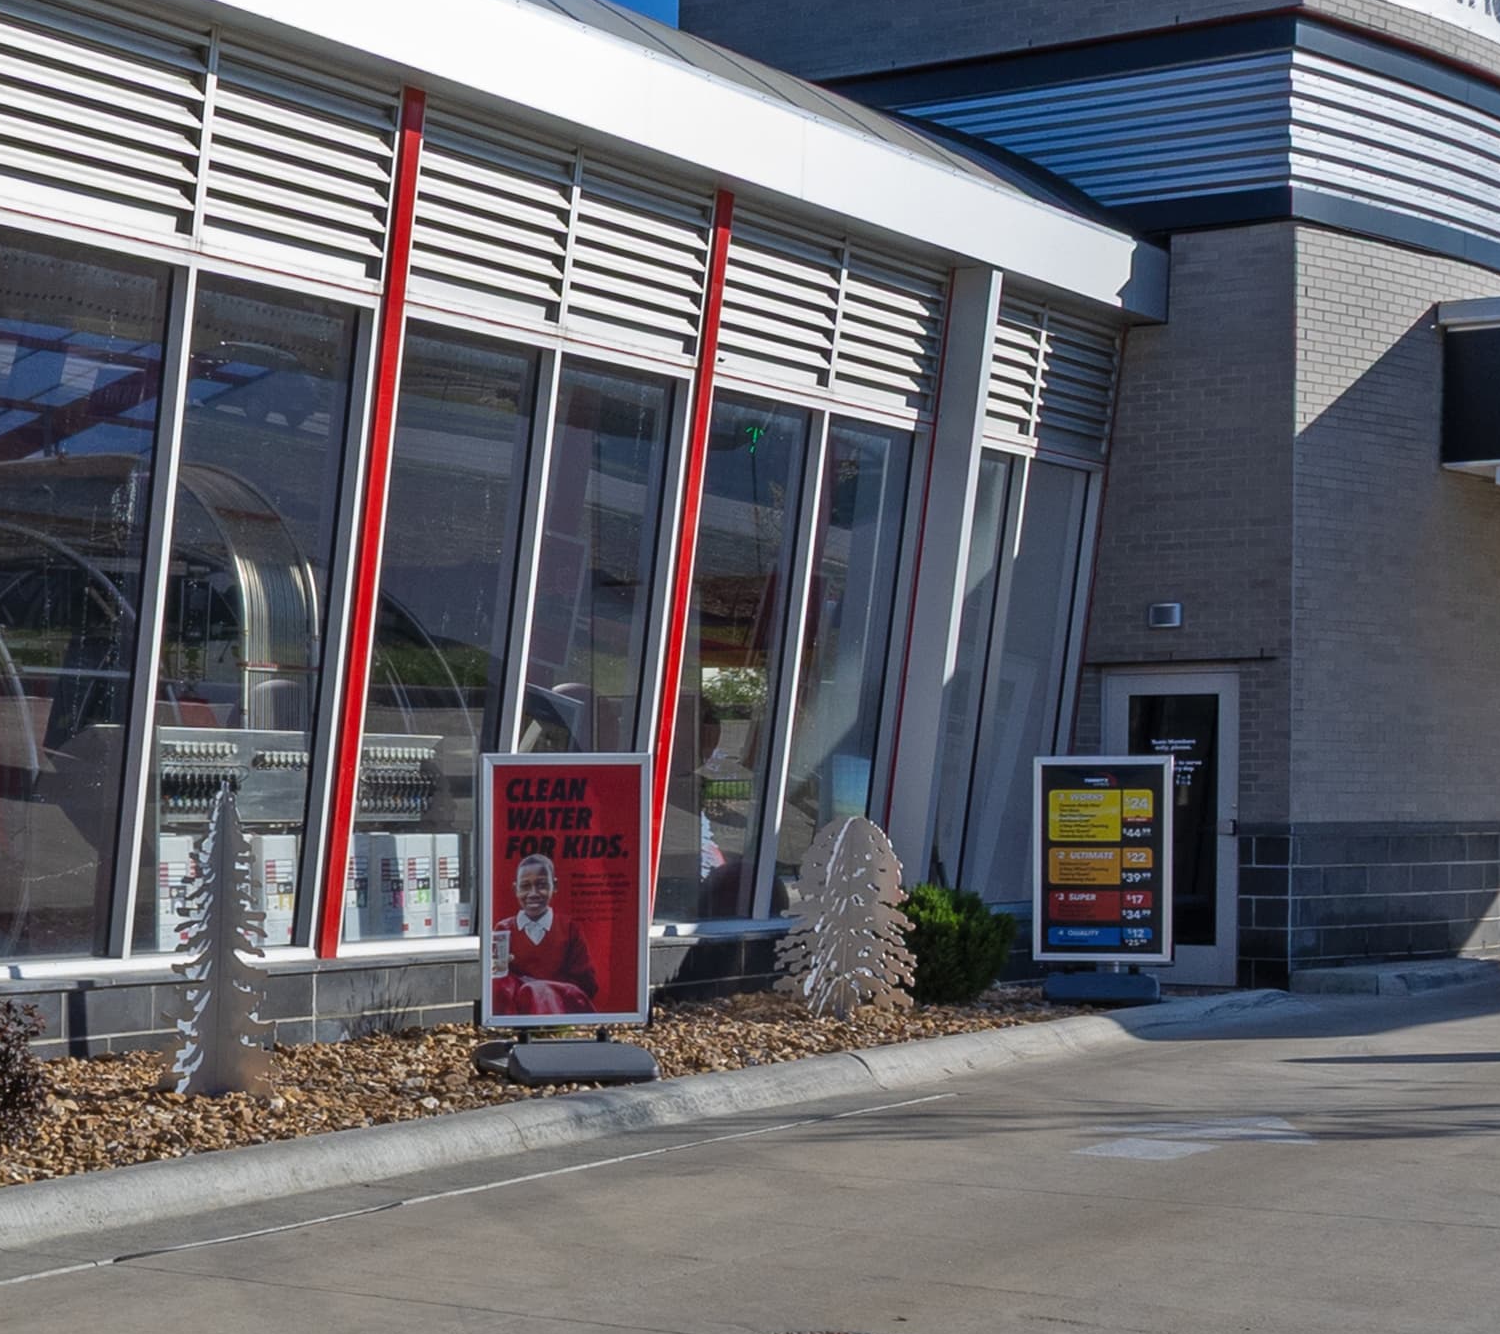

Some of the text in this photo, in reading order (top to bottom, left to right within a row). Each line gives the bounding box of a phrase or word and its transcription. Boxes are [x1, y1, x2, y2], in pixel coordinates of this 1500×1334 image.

[506, 778, 587, 802] CLEAN
[505, 807, 592, 831] WATER
[505, 834, 629, 859] FOR KIDS.
